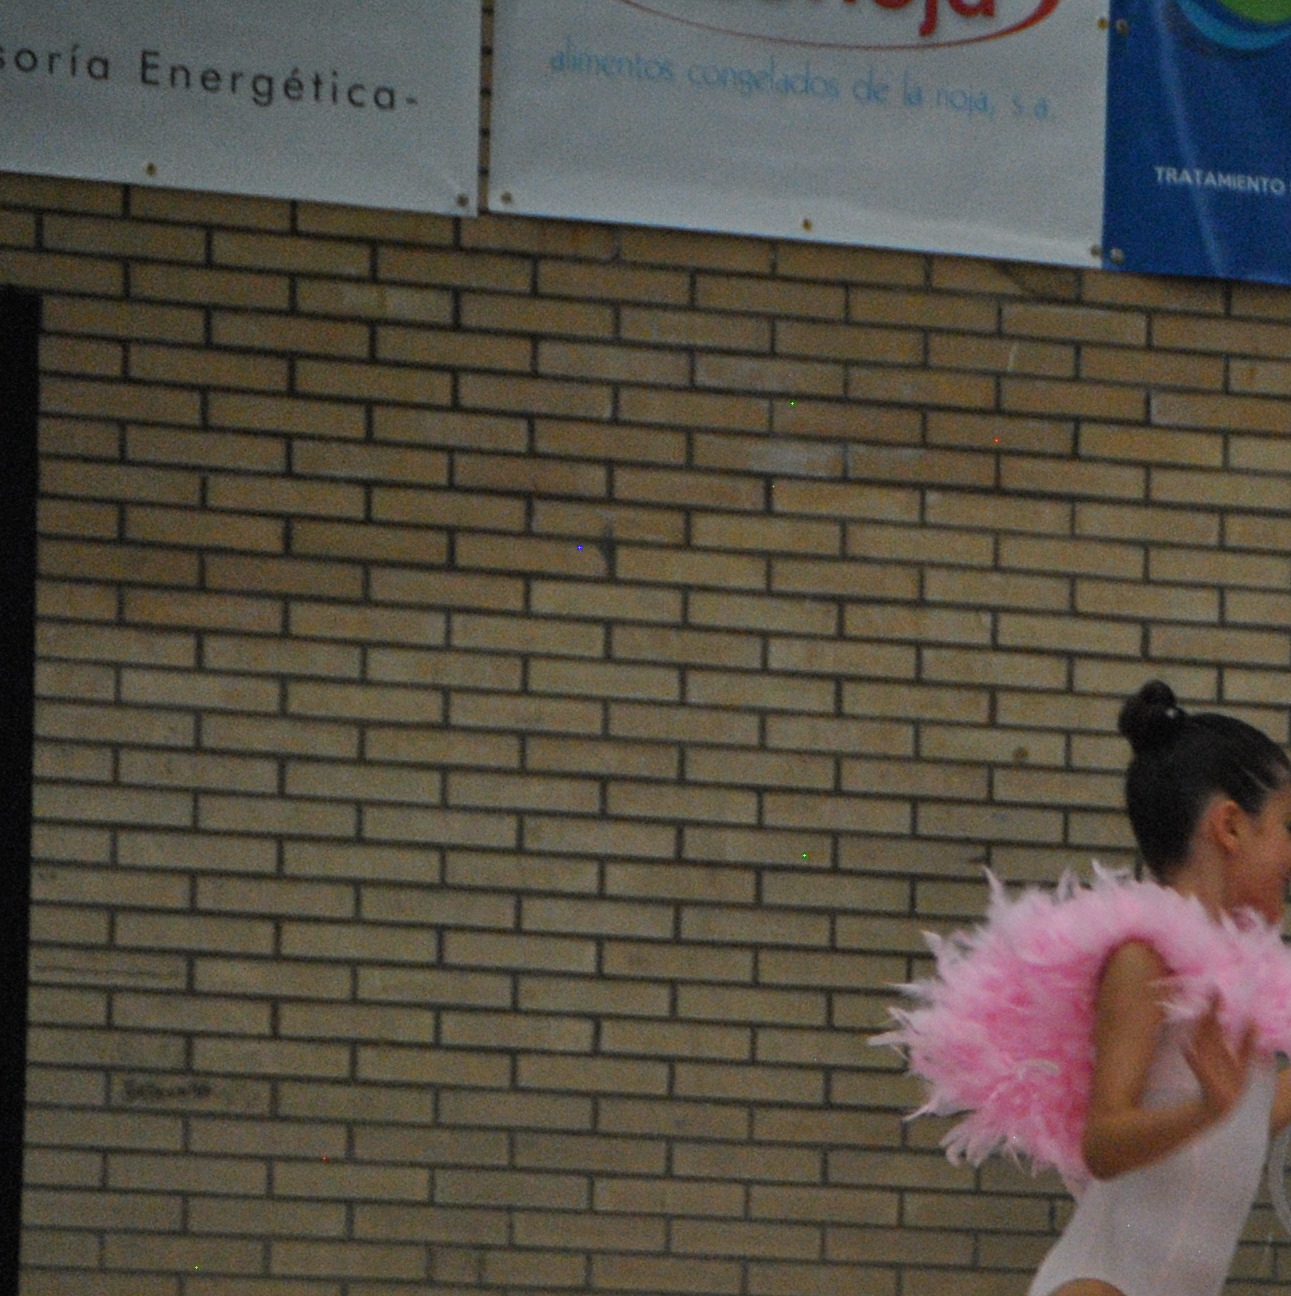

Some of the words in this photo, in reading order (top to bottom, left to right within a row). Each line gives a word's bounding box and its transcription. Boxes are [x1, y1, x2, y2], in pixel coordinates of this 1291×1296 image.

[550, 36, 675, 82] alimentos
[687, 53, 841, 99] congelados
[852, 66, 888, 104] de
[903, 70, 923, 107] la
[1154, 166, 1286, 195] TRATAMIENTO
